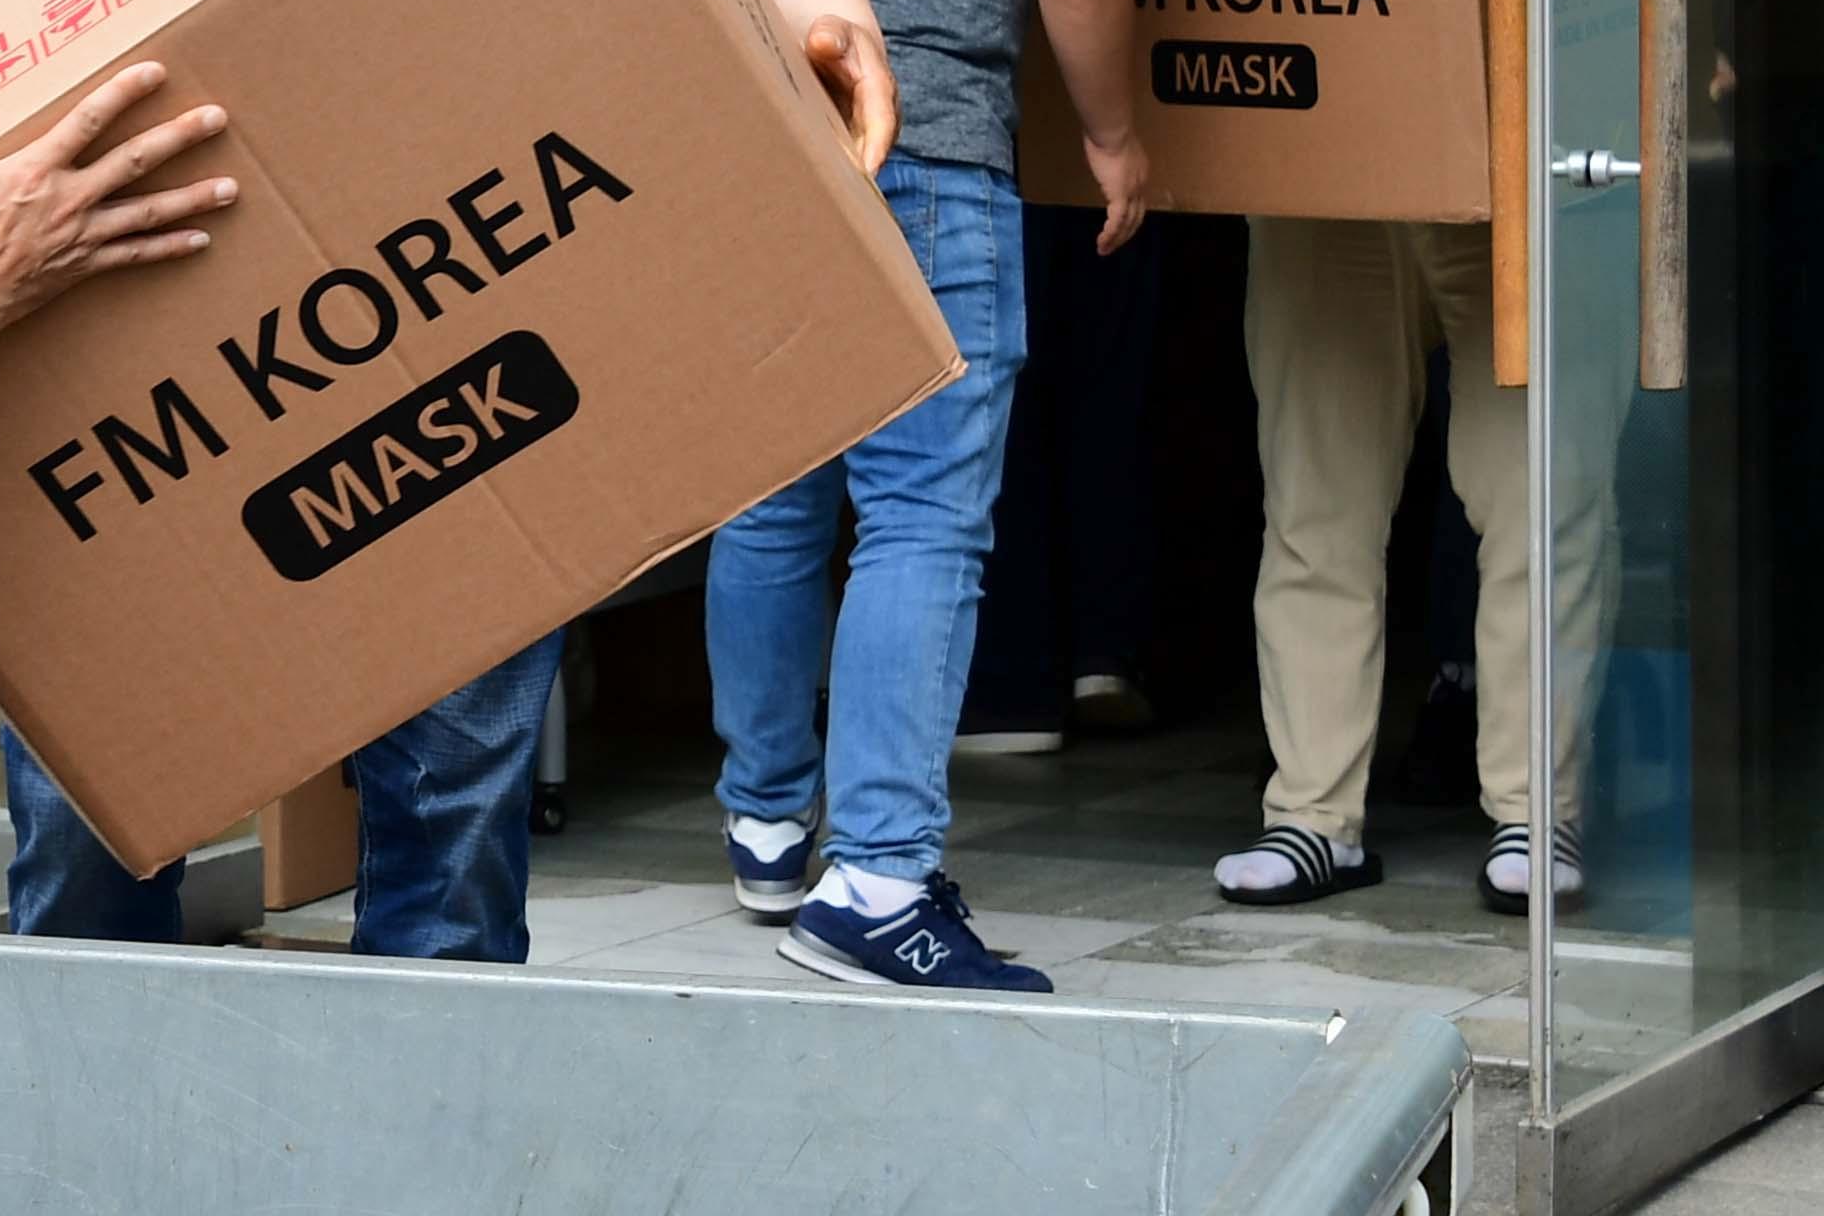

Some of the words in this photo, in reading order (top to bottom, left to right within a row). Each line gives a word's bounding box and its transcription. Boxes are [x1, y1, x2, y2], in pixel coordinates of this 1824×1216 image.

[1176, 53, 1296, 97] MASK
[27, 377, 230, 542] FM
[217, 131, 634, 422] KOREA
[289, 362, 540, 549] MASK
